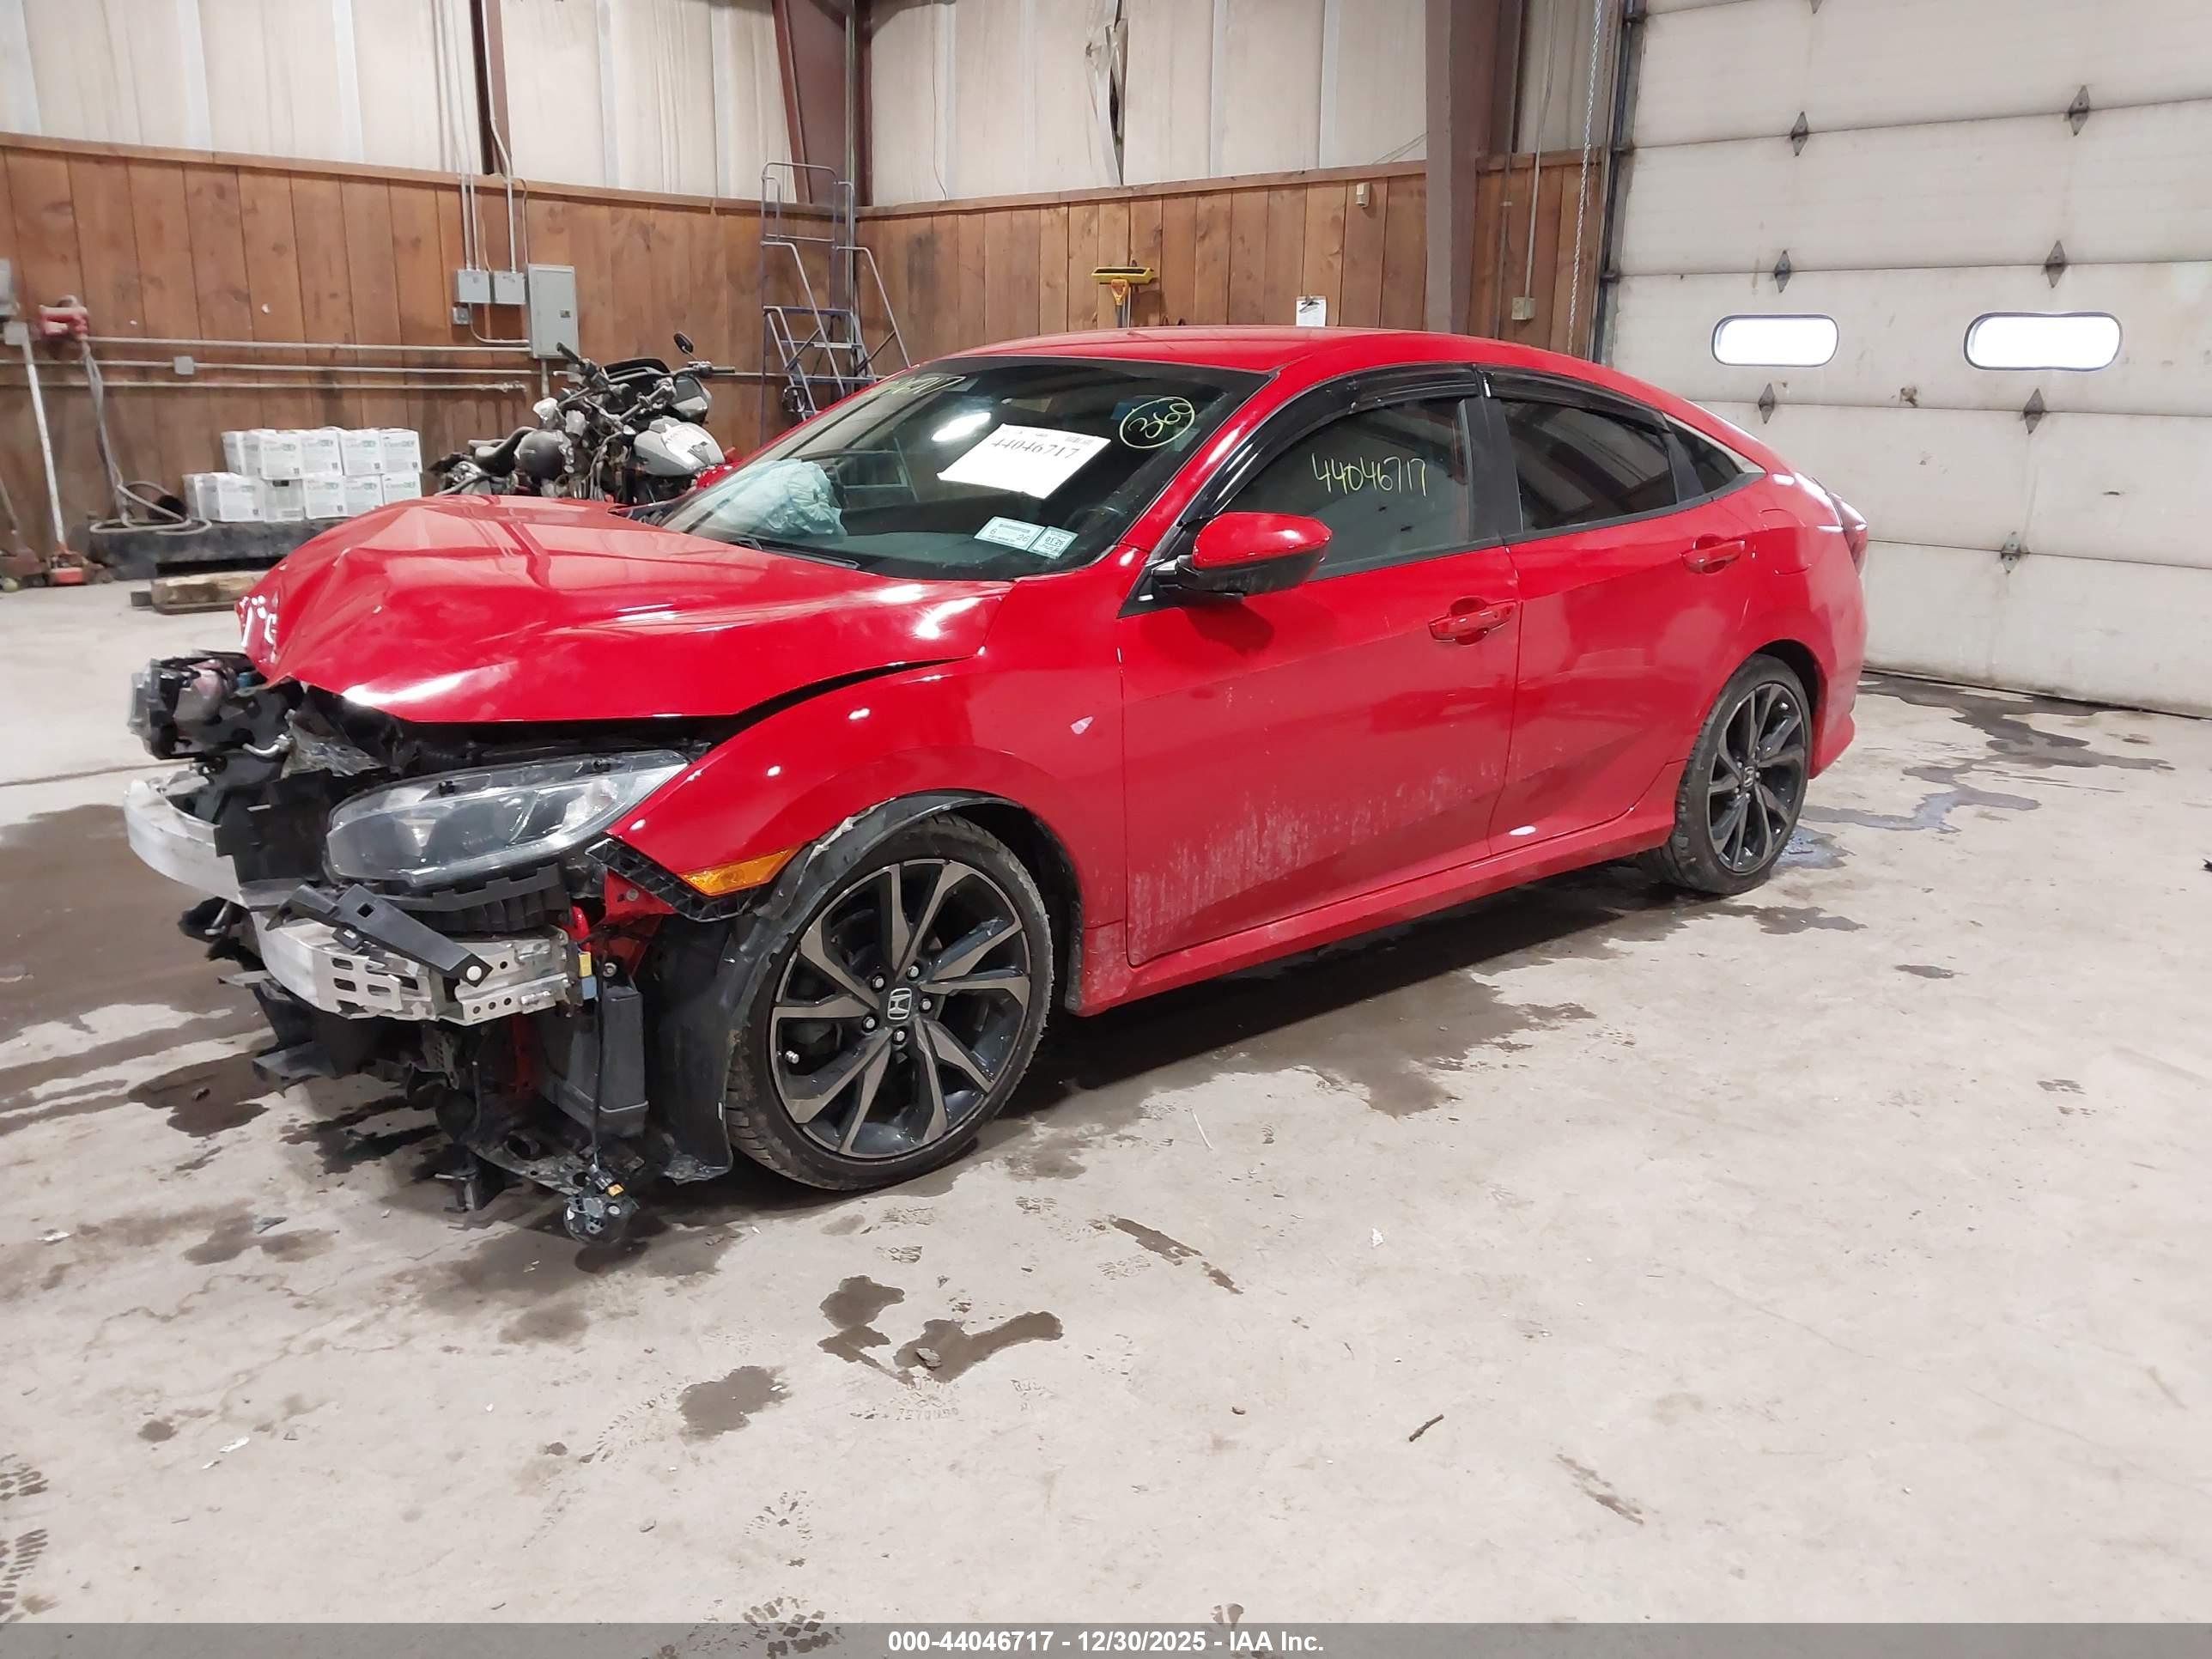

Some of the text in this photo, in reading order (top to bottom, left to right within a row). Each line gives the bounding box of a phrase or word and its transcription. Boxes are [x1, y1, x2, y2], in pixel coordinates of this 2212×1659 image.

[1127, 403, 1192, 439] 360
[991, 439, 1081, 459] 44046717
[1310, 453, 1427, 497] 44046717
